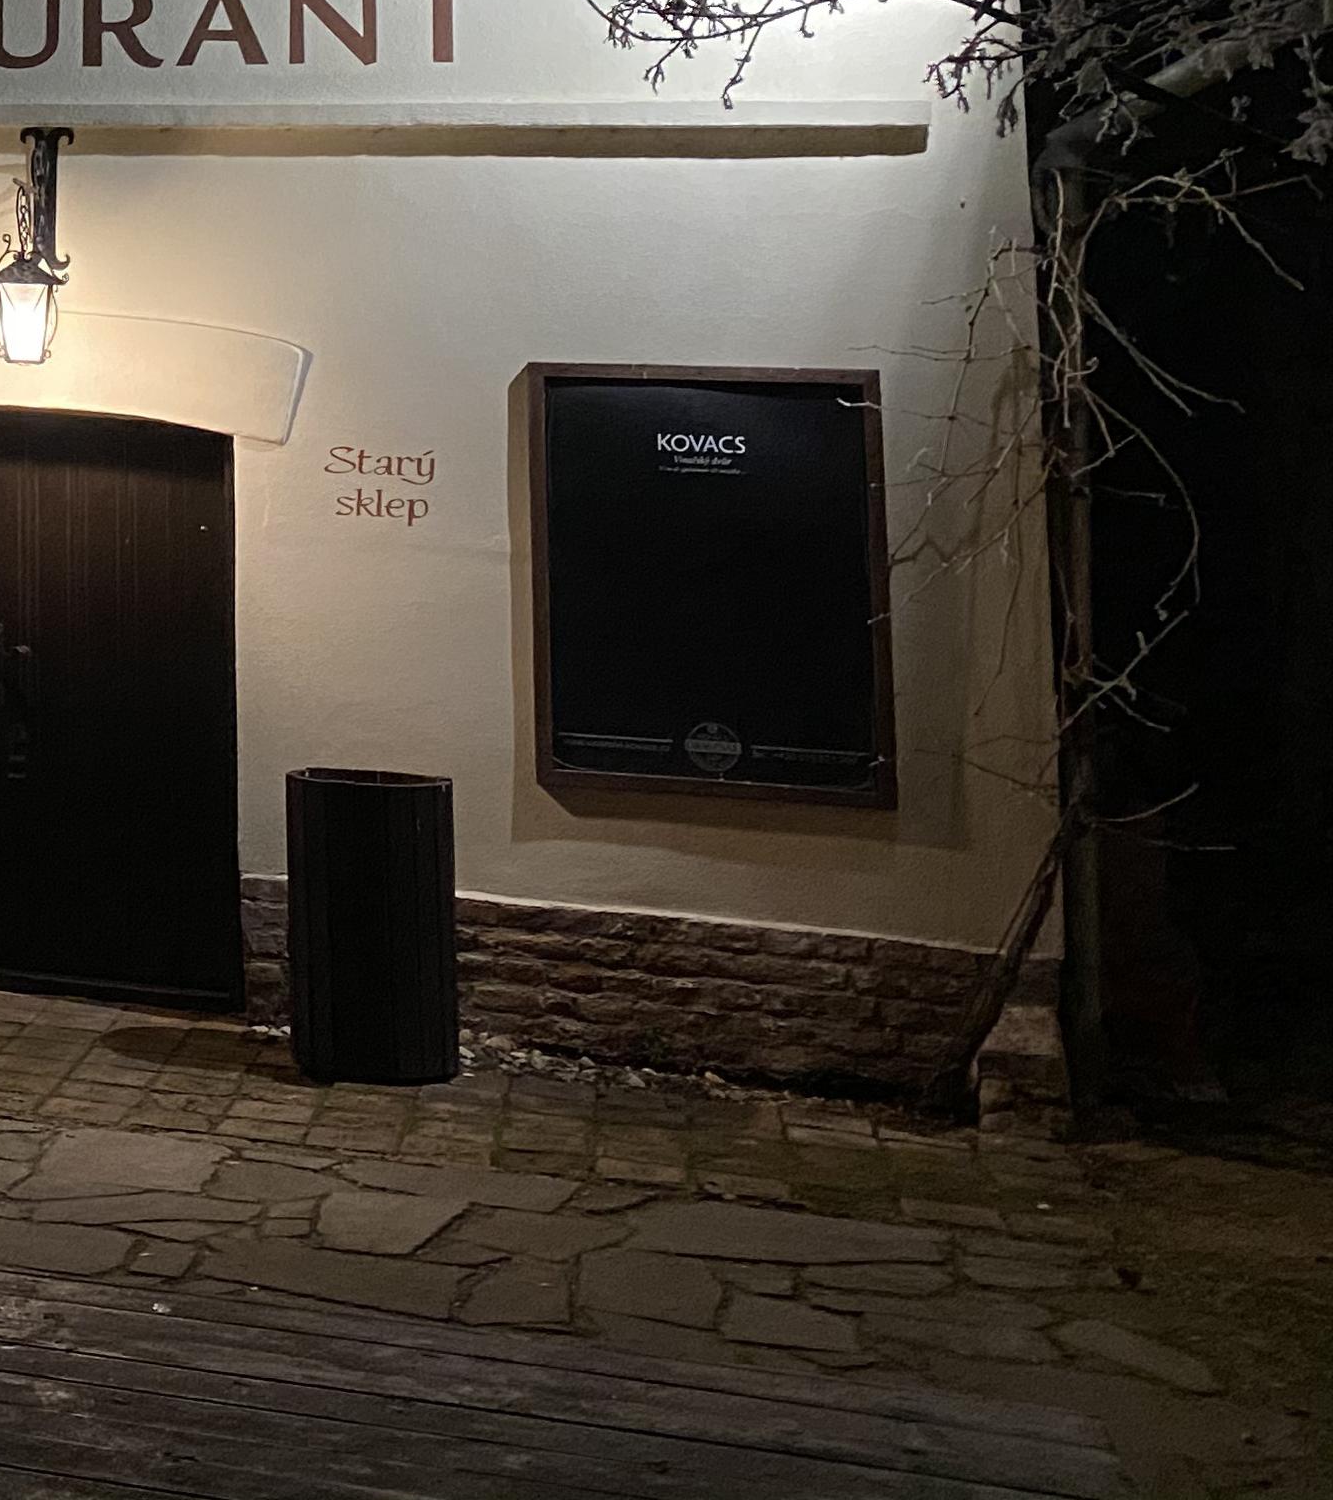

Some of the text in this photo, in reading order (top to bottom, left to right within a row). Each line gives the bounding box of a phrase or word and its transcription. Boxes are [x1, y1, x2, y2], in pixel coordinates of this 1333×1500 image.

[656, 432, 746, 455] KOVACS
[324, 445, 436, 486] Starý
[335, 488, 430, 528] sklep
